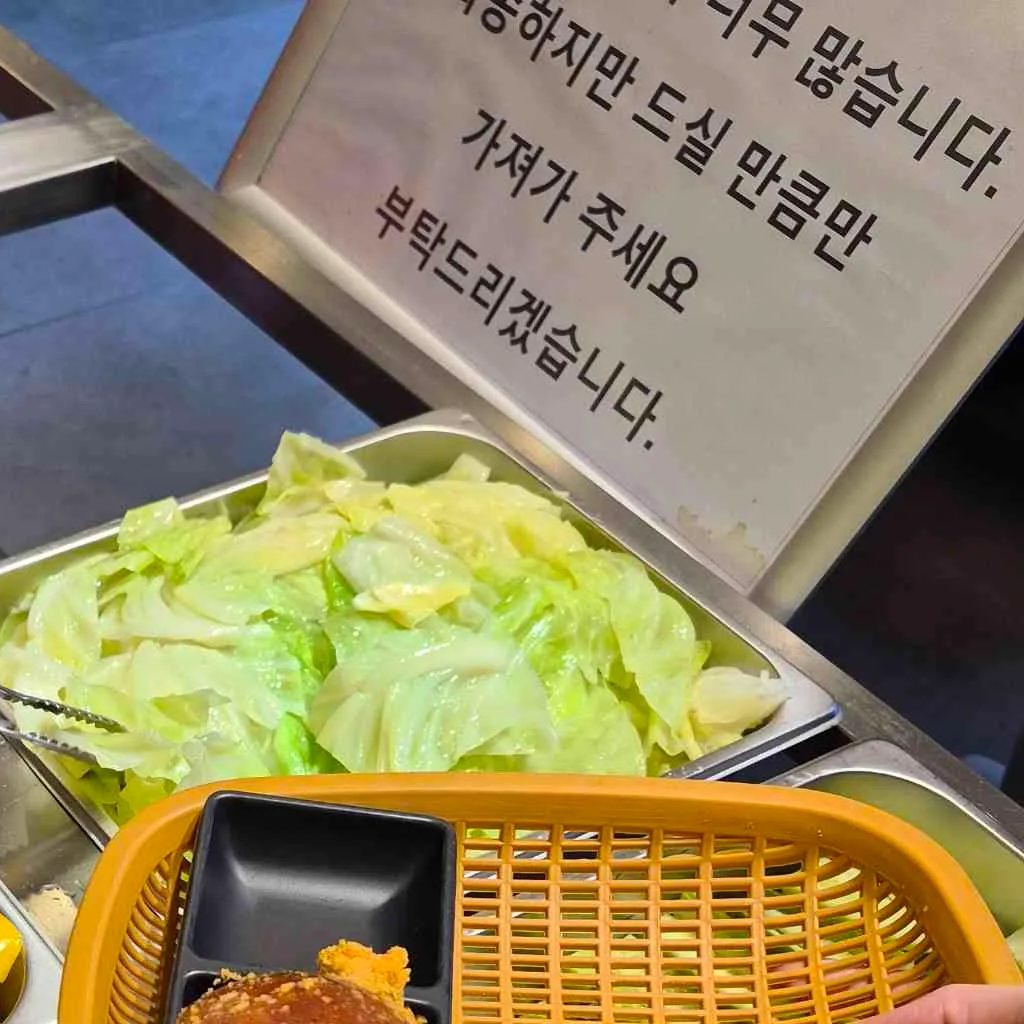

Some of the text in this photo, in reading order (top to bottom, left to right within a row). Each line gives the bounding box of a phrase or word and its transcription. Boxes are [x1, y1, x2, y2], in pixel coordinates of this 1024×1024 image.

[460, 0, 878, 273] 송하지만 드실 만큼만
[461, 108, 699, 314] 가져가 주세요
[706, 0, 1012, 200] 너무 많습니다.
[375, 185, 663, 451] 부탁드리겠습니다.
